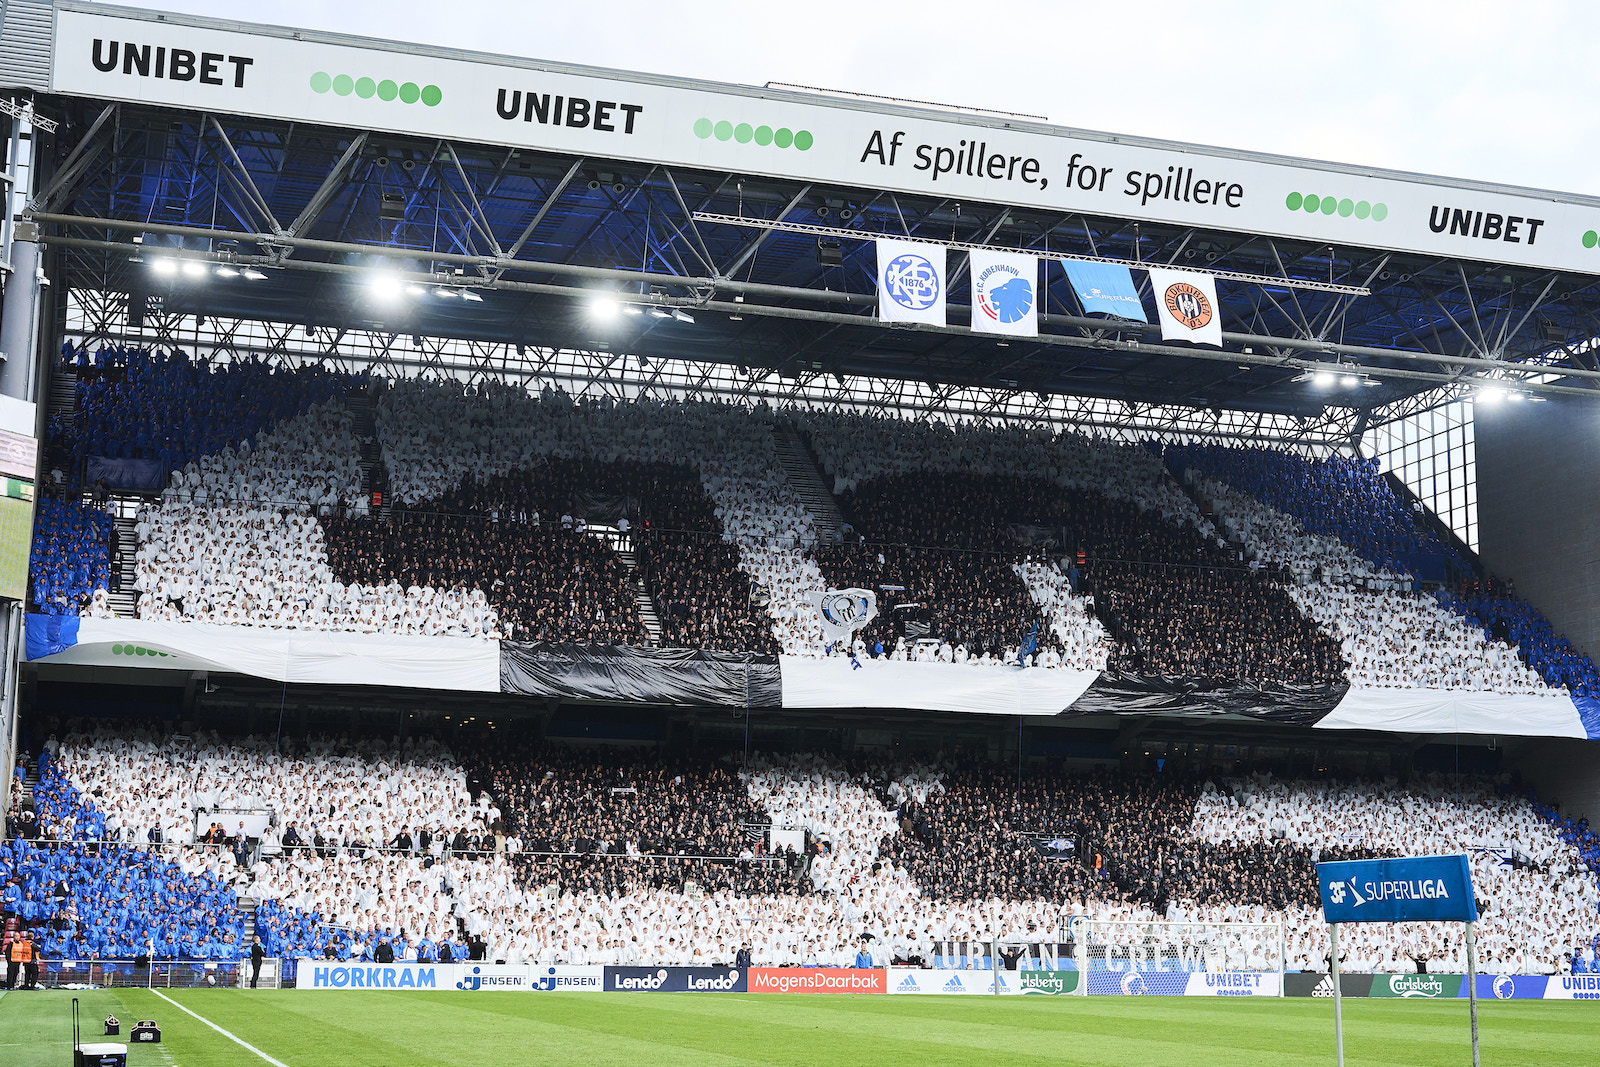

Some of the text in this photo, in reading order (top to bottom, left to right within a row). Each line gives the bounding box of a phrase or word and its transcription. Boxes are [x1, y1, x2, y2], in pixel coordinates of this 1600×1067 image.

[91, 38, 254, 88] UNIBET
[496, 88, 643, 135] UNIBET
[860, 129, 1244, 208] Af spillere, for spillere
[1429, 205, 1544, 245] UNIBET
[904, 278, 925, 289] 1876
[1167, 285, 1210, 317] BOLDKLUBBEN
[1329, 879, 1449, 904] 3F SUPERLIGA
[314, 967, 436, 988] HØRKRAM
[615, 973, 662, 990] Lendo
[687, 974, 733, 990] Lendo
[755, 972, 879, 992] MogensDaarbak
[1020, 974, 1063, 992] rlsberg
[1205, 973, 1262, 987] UNIBET
[1389, 974, 1442, 996] Carlsberg
